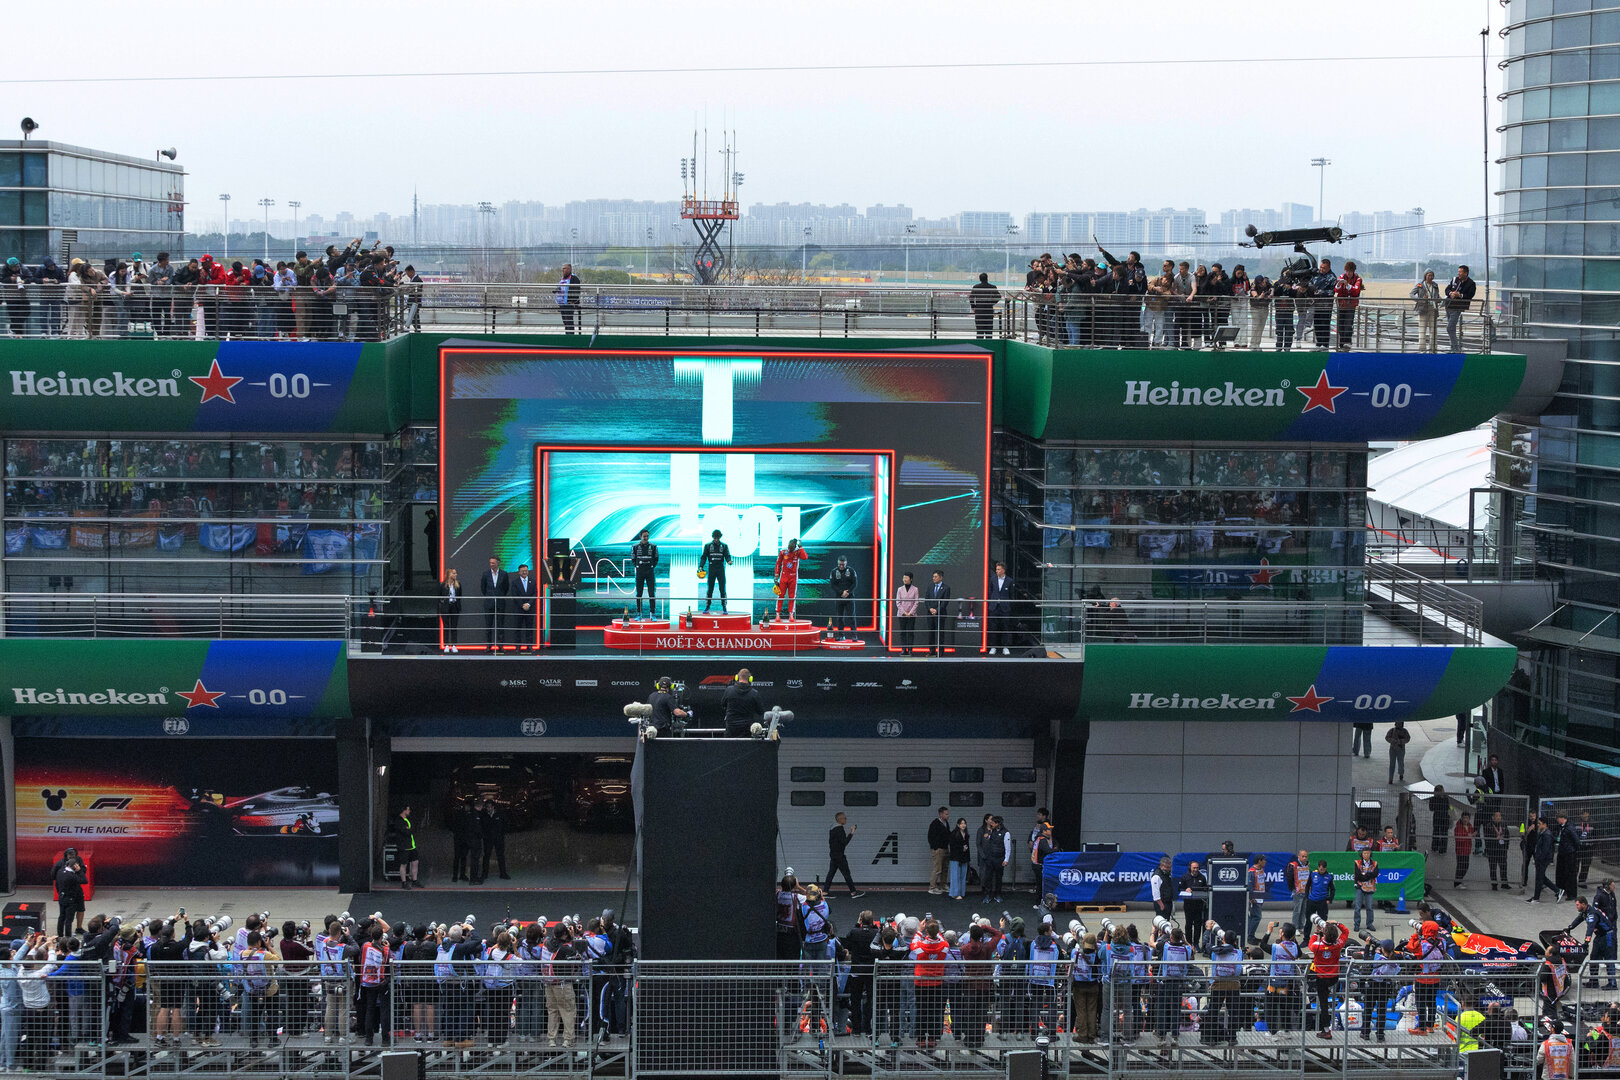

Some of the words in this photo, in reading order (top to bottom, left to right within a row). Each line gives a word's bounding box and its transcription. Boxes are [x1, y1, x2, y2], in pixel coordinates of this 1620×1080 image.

[712, 620, 720, 629] 1
[656, 635, 694, 649] MOËT
[696, 637, 706, 649] &
[707, 637, 772, 649] CHANDON
[165, 720, 188, 731] FIA
[522, 721, 545, 733] FIA
[879, 722, 901, 734] FIA
[47, 826, 71, 834] FUEL
[74, 826, 94, 834] THE
[96, 826, 129, 834] MAGIC
[871, 832, 898, 865] A
[1060, 870, 1080, 883] FIA
[1084, 871, 1115, 882] PARC
[1219, 869, 1237, 880] FIA
[1560, 946, 1578, 954] Mobil
